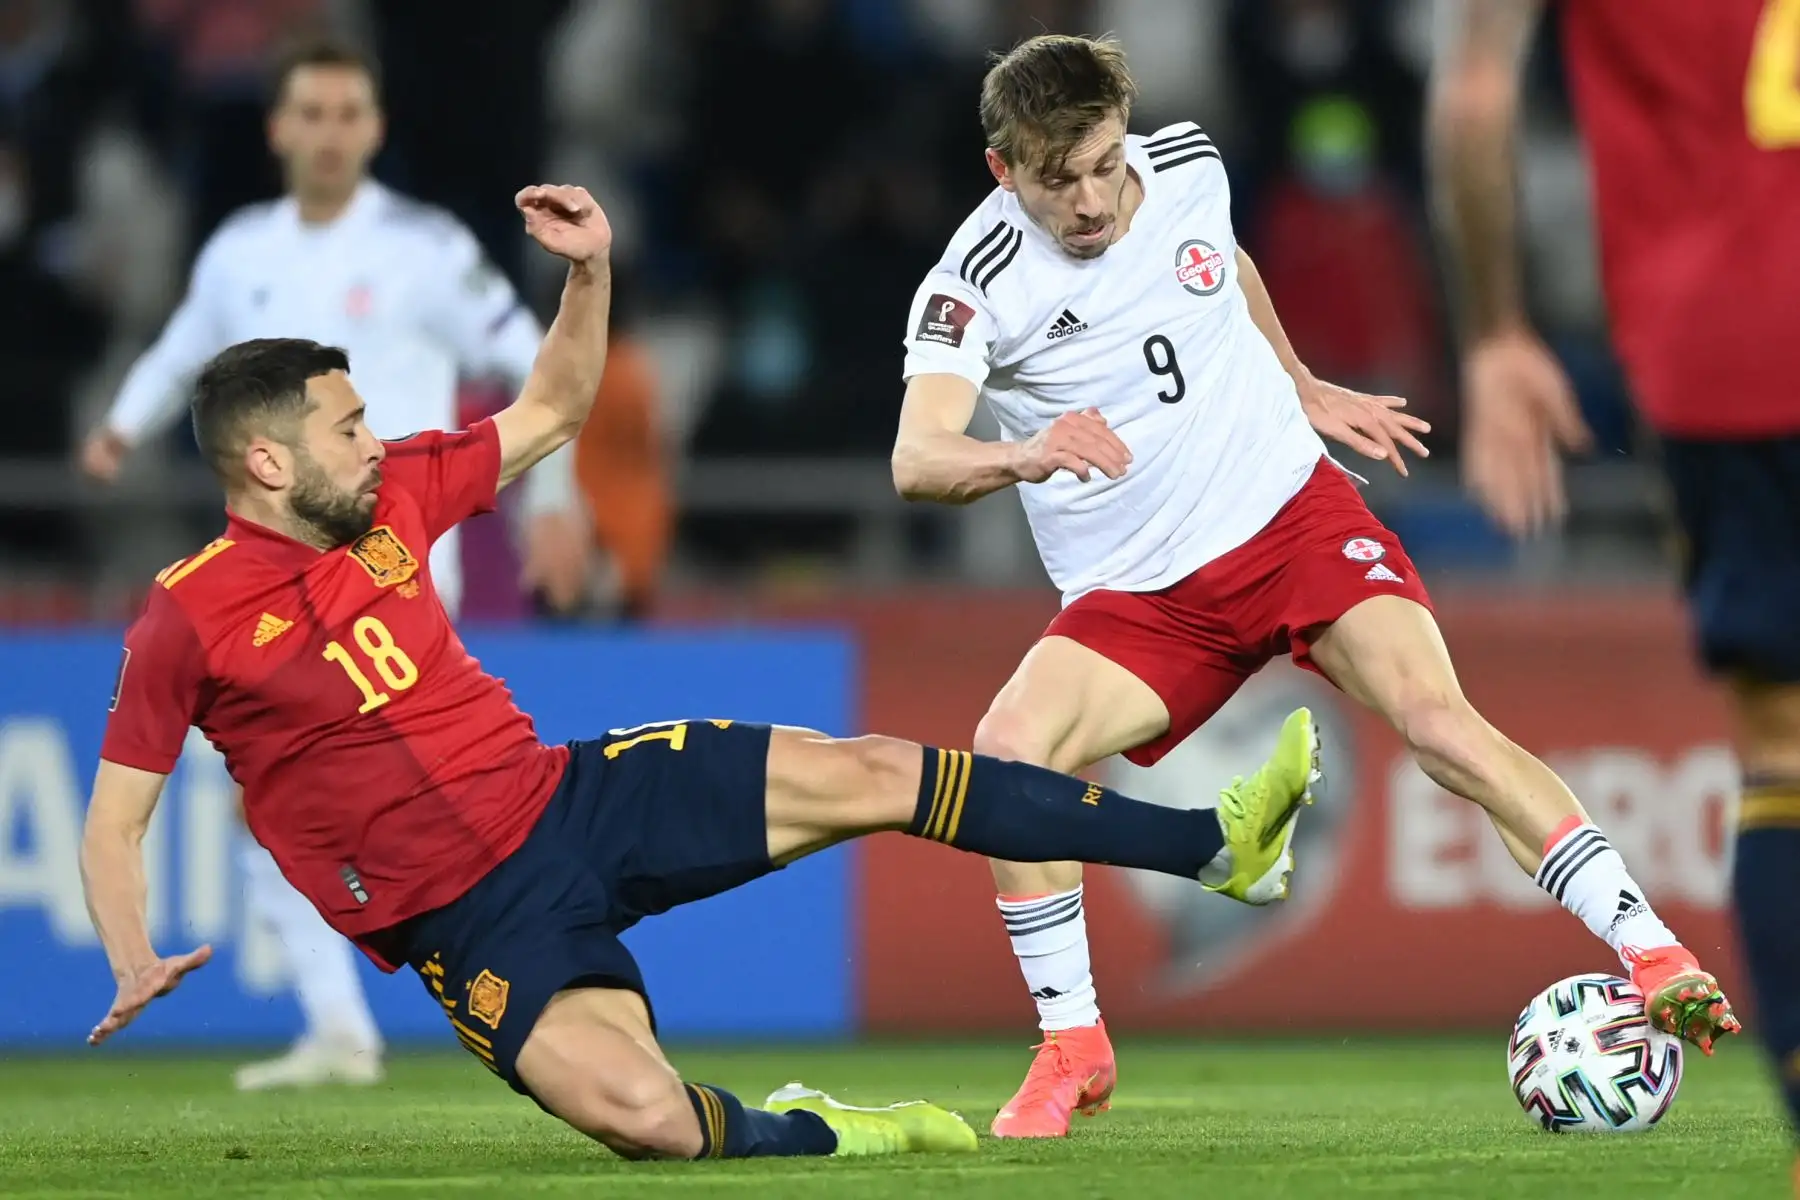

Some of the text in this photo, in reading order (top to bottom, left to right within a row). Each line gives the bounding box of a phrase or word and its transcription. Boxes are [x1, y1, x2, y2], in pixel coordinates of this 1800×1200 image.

[1177, 253, 1223, 281] Georgia
[1046, 322, 1088, 340] adidas
[1142, 334, 1186, 404] 9
[322, 616, 419, 714] 18
[603, 719, 690, 760] 1
